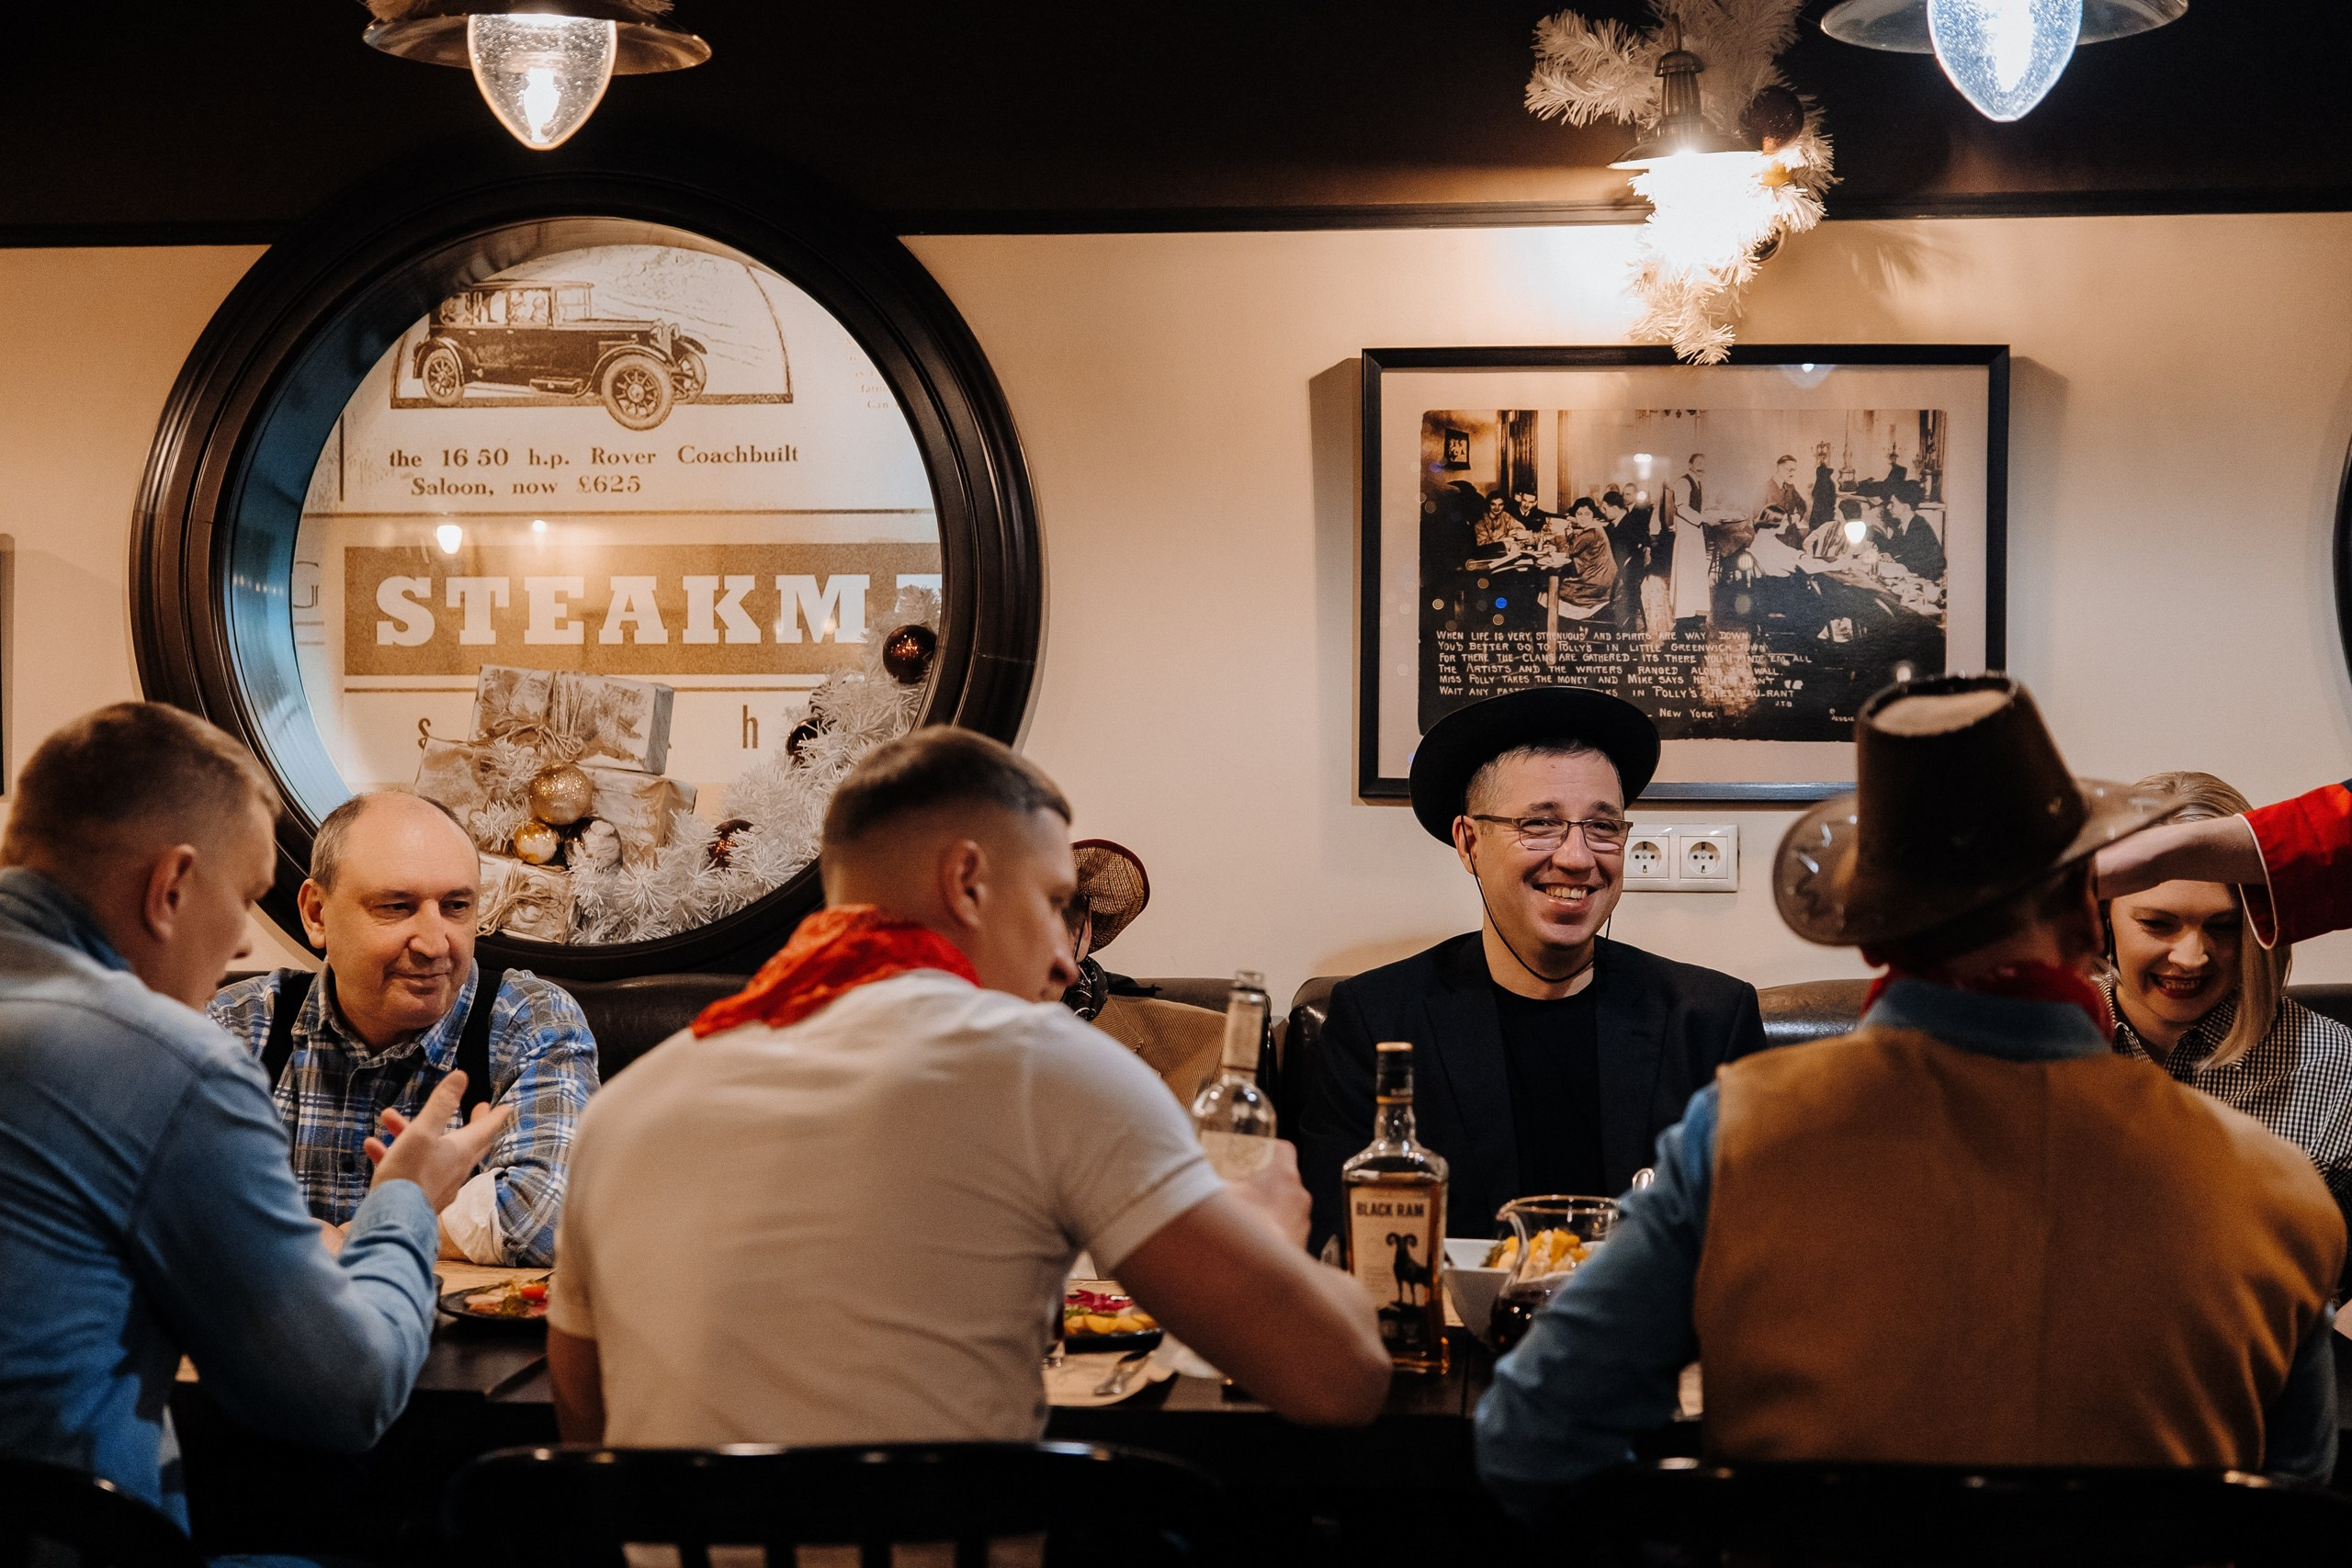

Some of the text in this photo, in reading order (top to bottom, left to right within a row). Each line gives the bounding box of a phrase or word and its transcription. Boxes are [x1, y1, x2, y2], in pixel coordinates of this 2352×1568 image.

[389, 448, 423, 468] the
[528, 447, 570, 469] h.p.
[590, 446, 657, 466] Rover
[676, 445, 799, 465] Coachbuilt
[411, 474, 641, 498] Saloon, now £625
[1436, 631, 1464, 640] WHEN
[1471, 632, 1488, 640] LIFE
[1494, 632, 1504, 640] IS
[1508, 632, 1531, 641] VERY
[1593, 632, 1611, 641] AND
[1616, 632, 1652, 641] SPIRITS
[1658, 632, 1677, 640] ARE
[1685, 632, 1706, 640] WAY
[1719, 631, 1750, 640] DOWN
[1439, 641, 1464, 651] YOU'D
[1469, 642, 1509, 651] BETTER
[1517, 643, 1531, 651] GO
[1537, 643, 1550, 651] TO
[1557, 640, 1592, 652] POLLY'S
[1630, 643, 1662, 652] LITTLE
[1440, 653, 1455, 662] FOR
[1462, 653, 1488, 662] THERE
[1497, 654, 1513, 662] THE
[1522, 653, 1554, 662] CLANS
[1558, 653, 1577, 661] ARE
[1642, 654, 1659, 662] ITS
[1664, 654, 1697, 662] THERE
[1792, 654, 1813, 662] ALL
[1439, 664, 1457, 673] THE
[1466, 663, 1511, 673] ARTISTS
[1519, 665, 1541, 673] AND
[1548, 665, 1567, 673] THE
[1576, 665, 1623, 673] WRITERS
[1637, 666, 1679, 674] RANGED
[1440, 675, 1462, 683] MISS
[1469, 674, 1495, 684] POLLY
[1501, 675, 1530, 683] TAKES
[1599, 676, 1618, 684] AND
[1627, 674, 1653, 683] MIKE
[1658, 676, 1684, 684] SAYS
[1693, 675, 1706, 683] HE
[1439, 686, 1463, 695] WAIT
[1469, 687, 1488, 695] ANY
[1652, 685, 1698, 698] POLLY'S
[1659, 708, 1714, 718] NEW YORK
[1355, 1201, 1426, 1219] BLACK RAM
